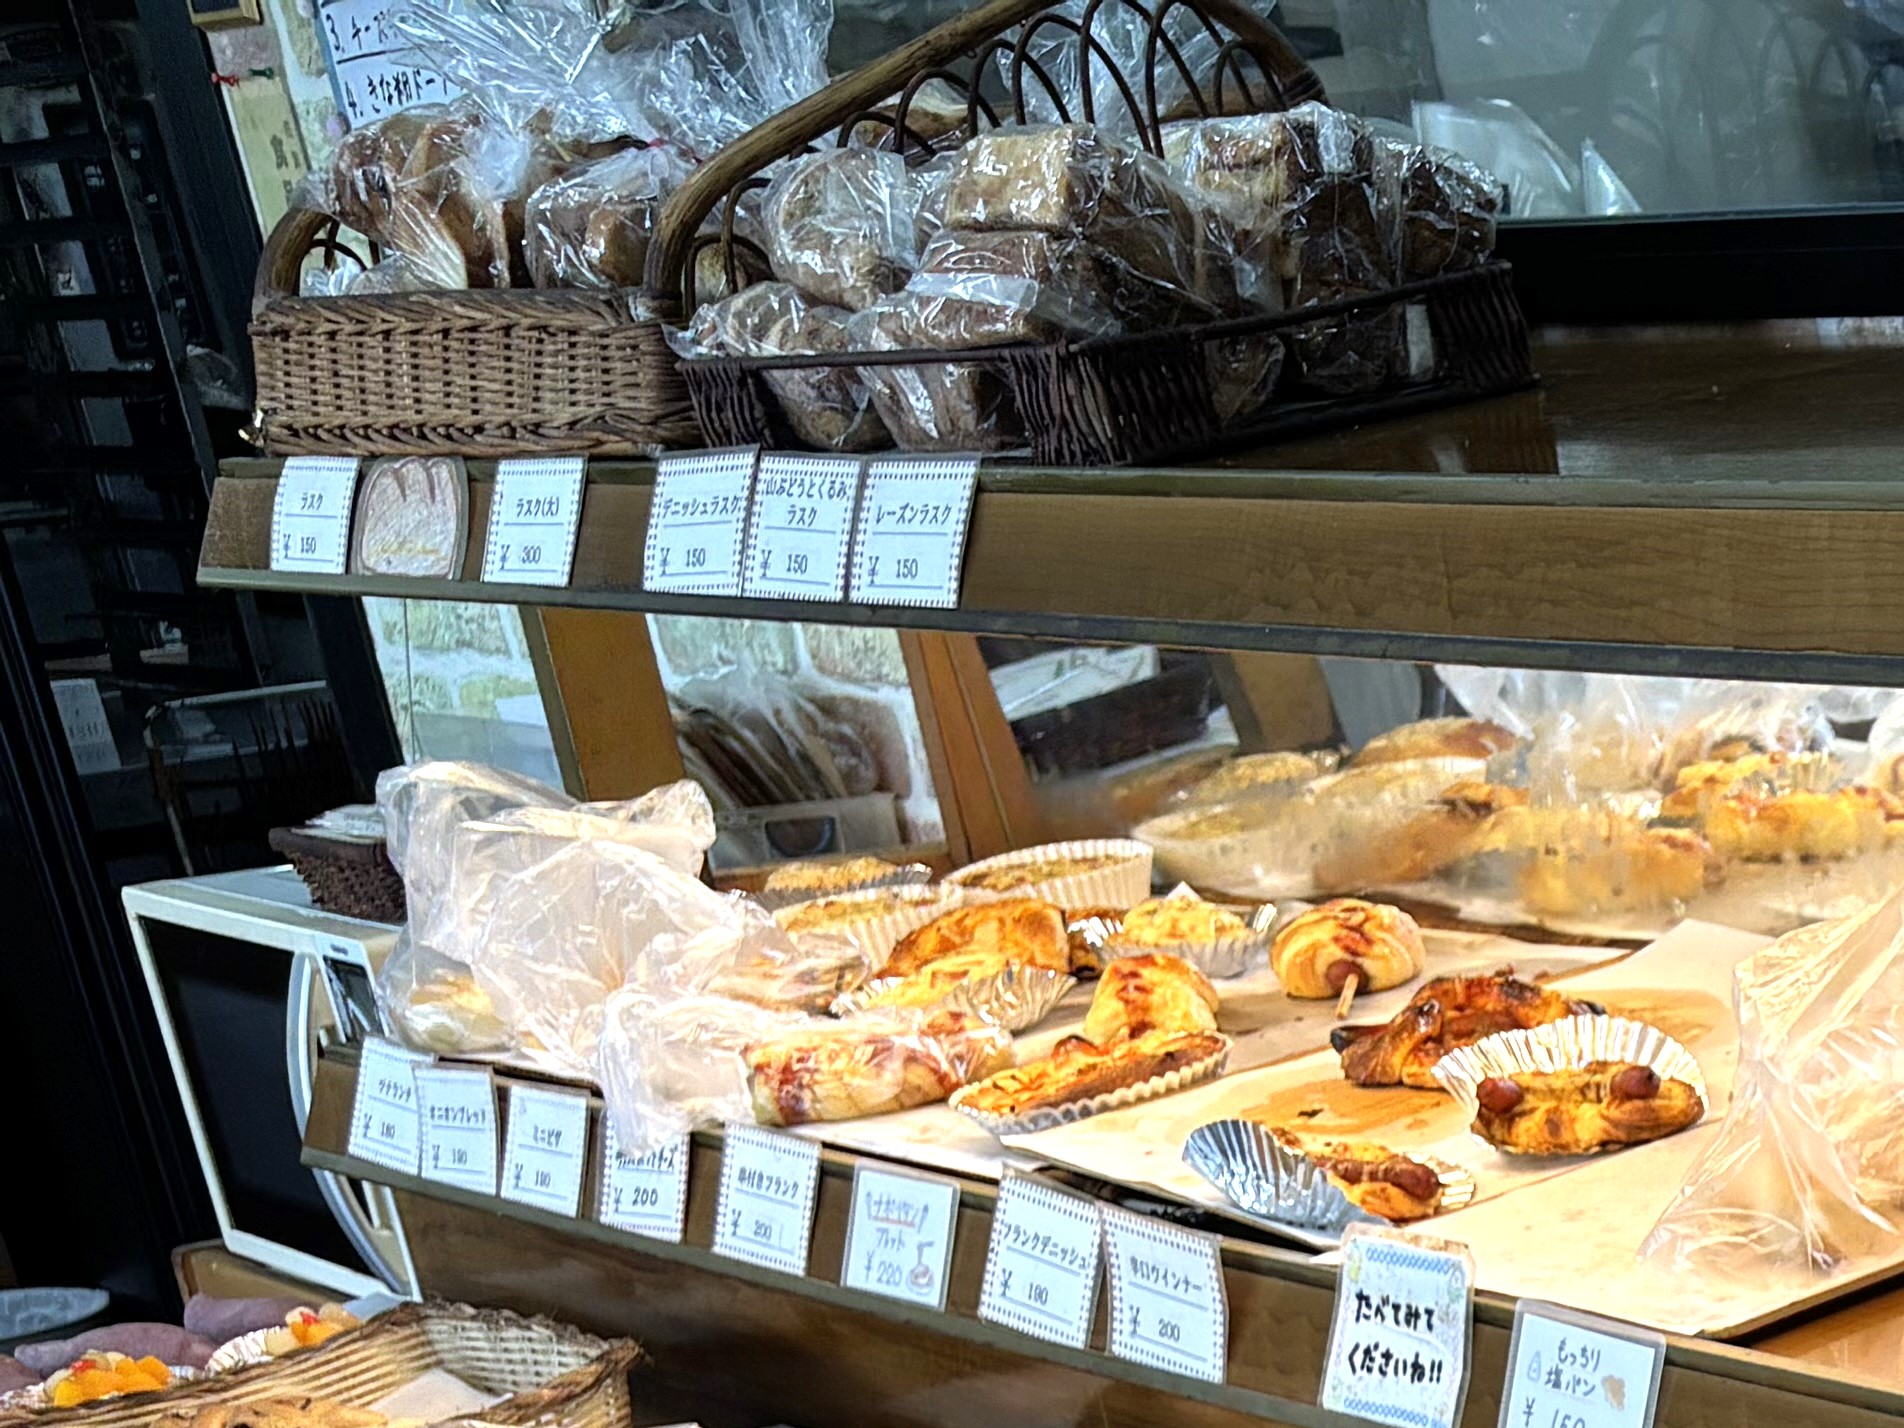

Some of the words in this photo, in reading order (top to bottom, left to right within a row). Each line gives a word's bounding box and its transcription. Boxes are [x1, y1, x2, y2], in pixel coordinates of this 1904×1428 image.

[300, 492, 323, 510] ラスク
[662, 495, 742, 519] デニッシュラスク
[787, 505, 817, 527] ラスク
[876, 503, 951, 526] レーズンラスク
[686, 548, 706, 567] 150
[787, 554, 808, 574] 150
[896, 558, 918, 579] 150
[632, 1187, 658, 1208] 200
[1355, 1288, 1435, 1331] たべてみて
[1159, 1319, 1180, 1342] 200
[1557, 1337, 1601, 1372] もっちり
[1545, 1366, 1596, 1398] 塩パン
